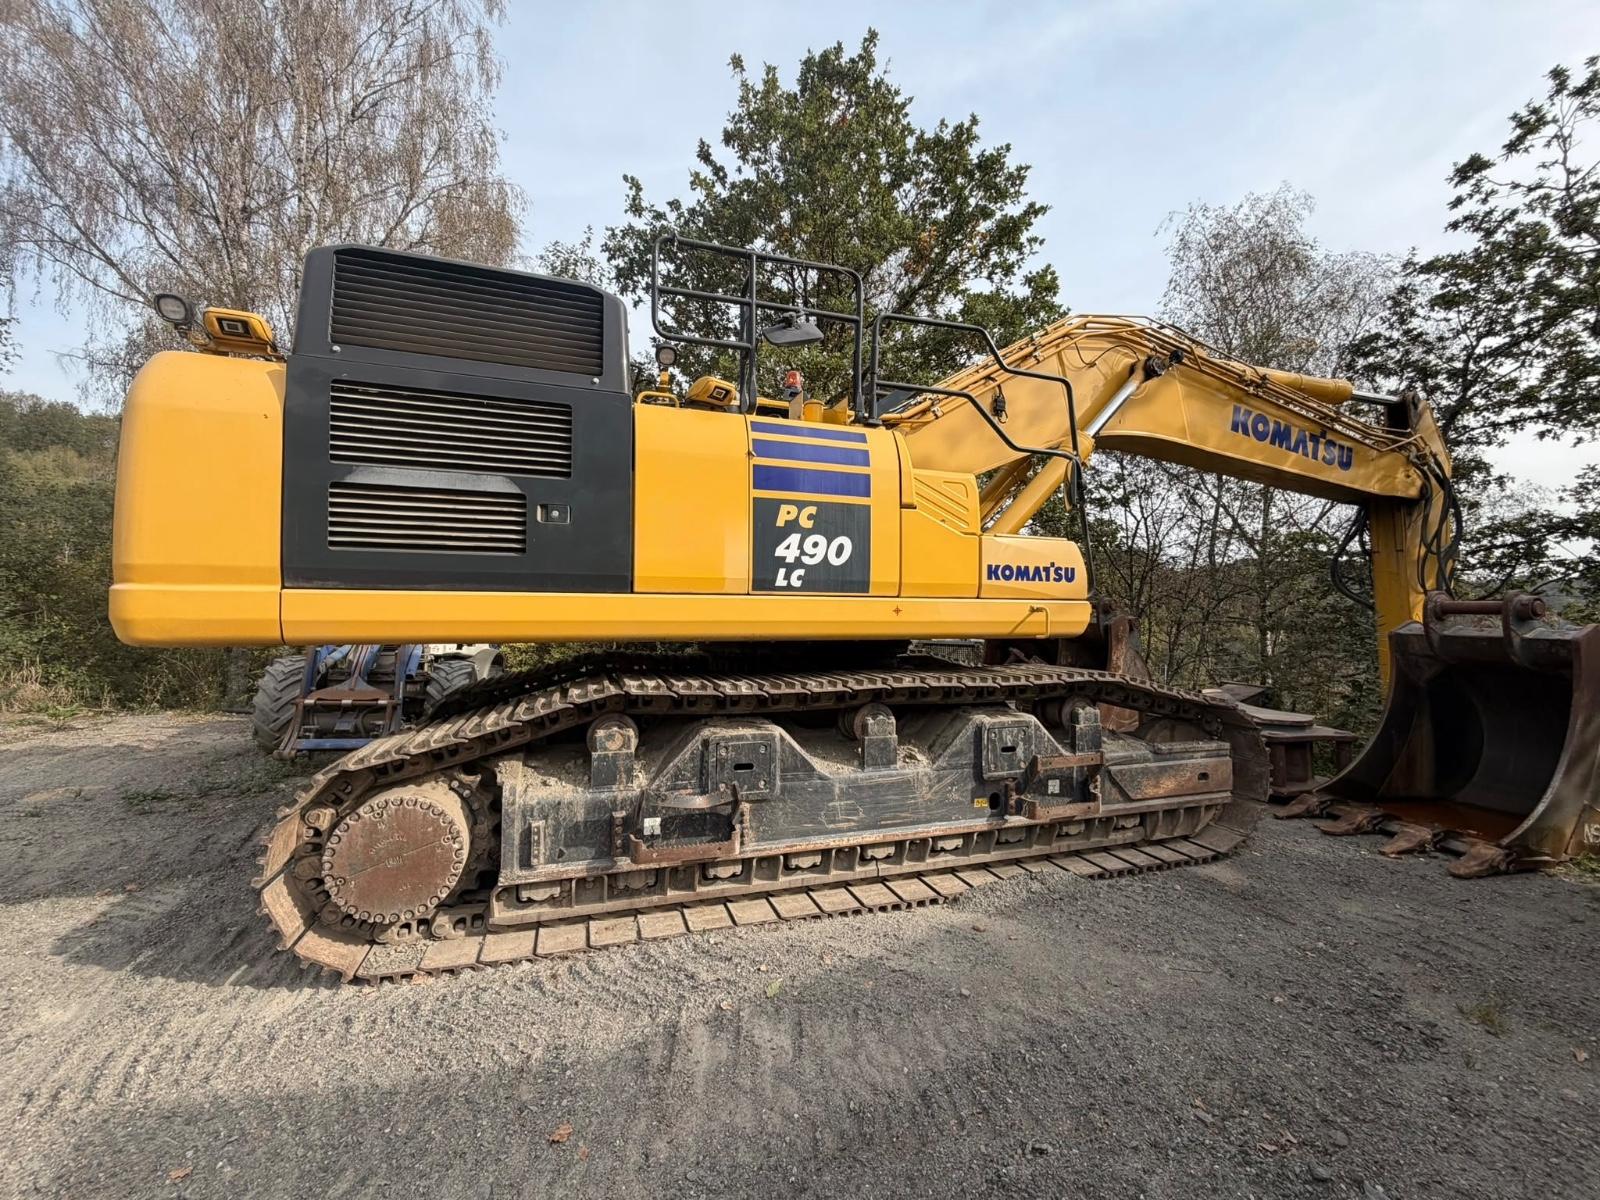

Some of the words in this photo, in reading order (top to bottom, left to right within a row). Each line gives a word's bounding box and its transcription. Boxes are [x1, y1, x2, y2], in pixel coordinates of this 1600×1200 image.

[1231, 404, 1354, 472] KOMATSU
[776, 504, 817, 528] PC
[774, 533, 852, 566] 490
[775, 568, 805, 587] LC
[987, 561, 1075, 583] KOMATSU
